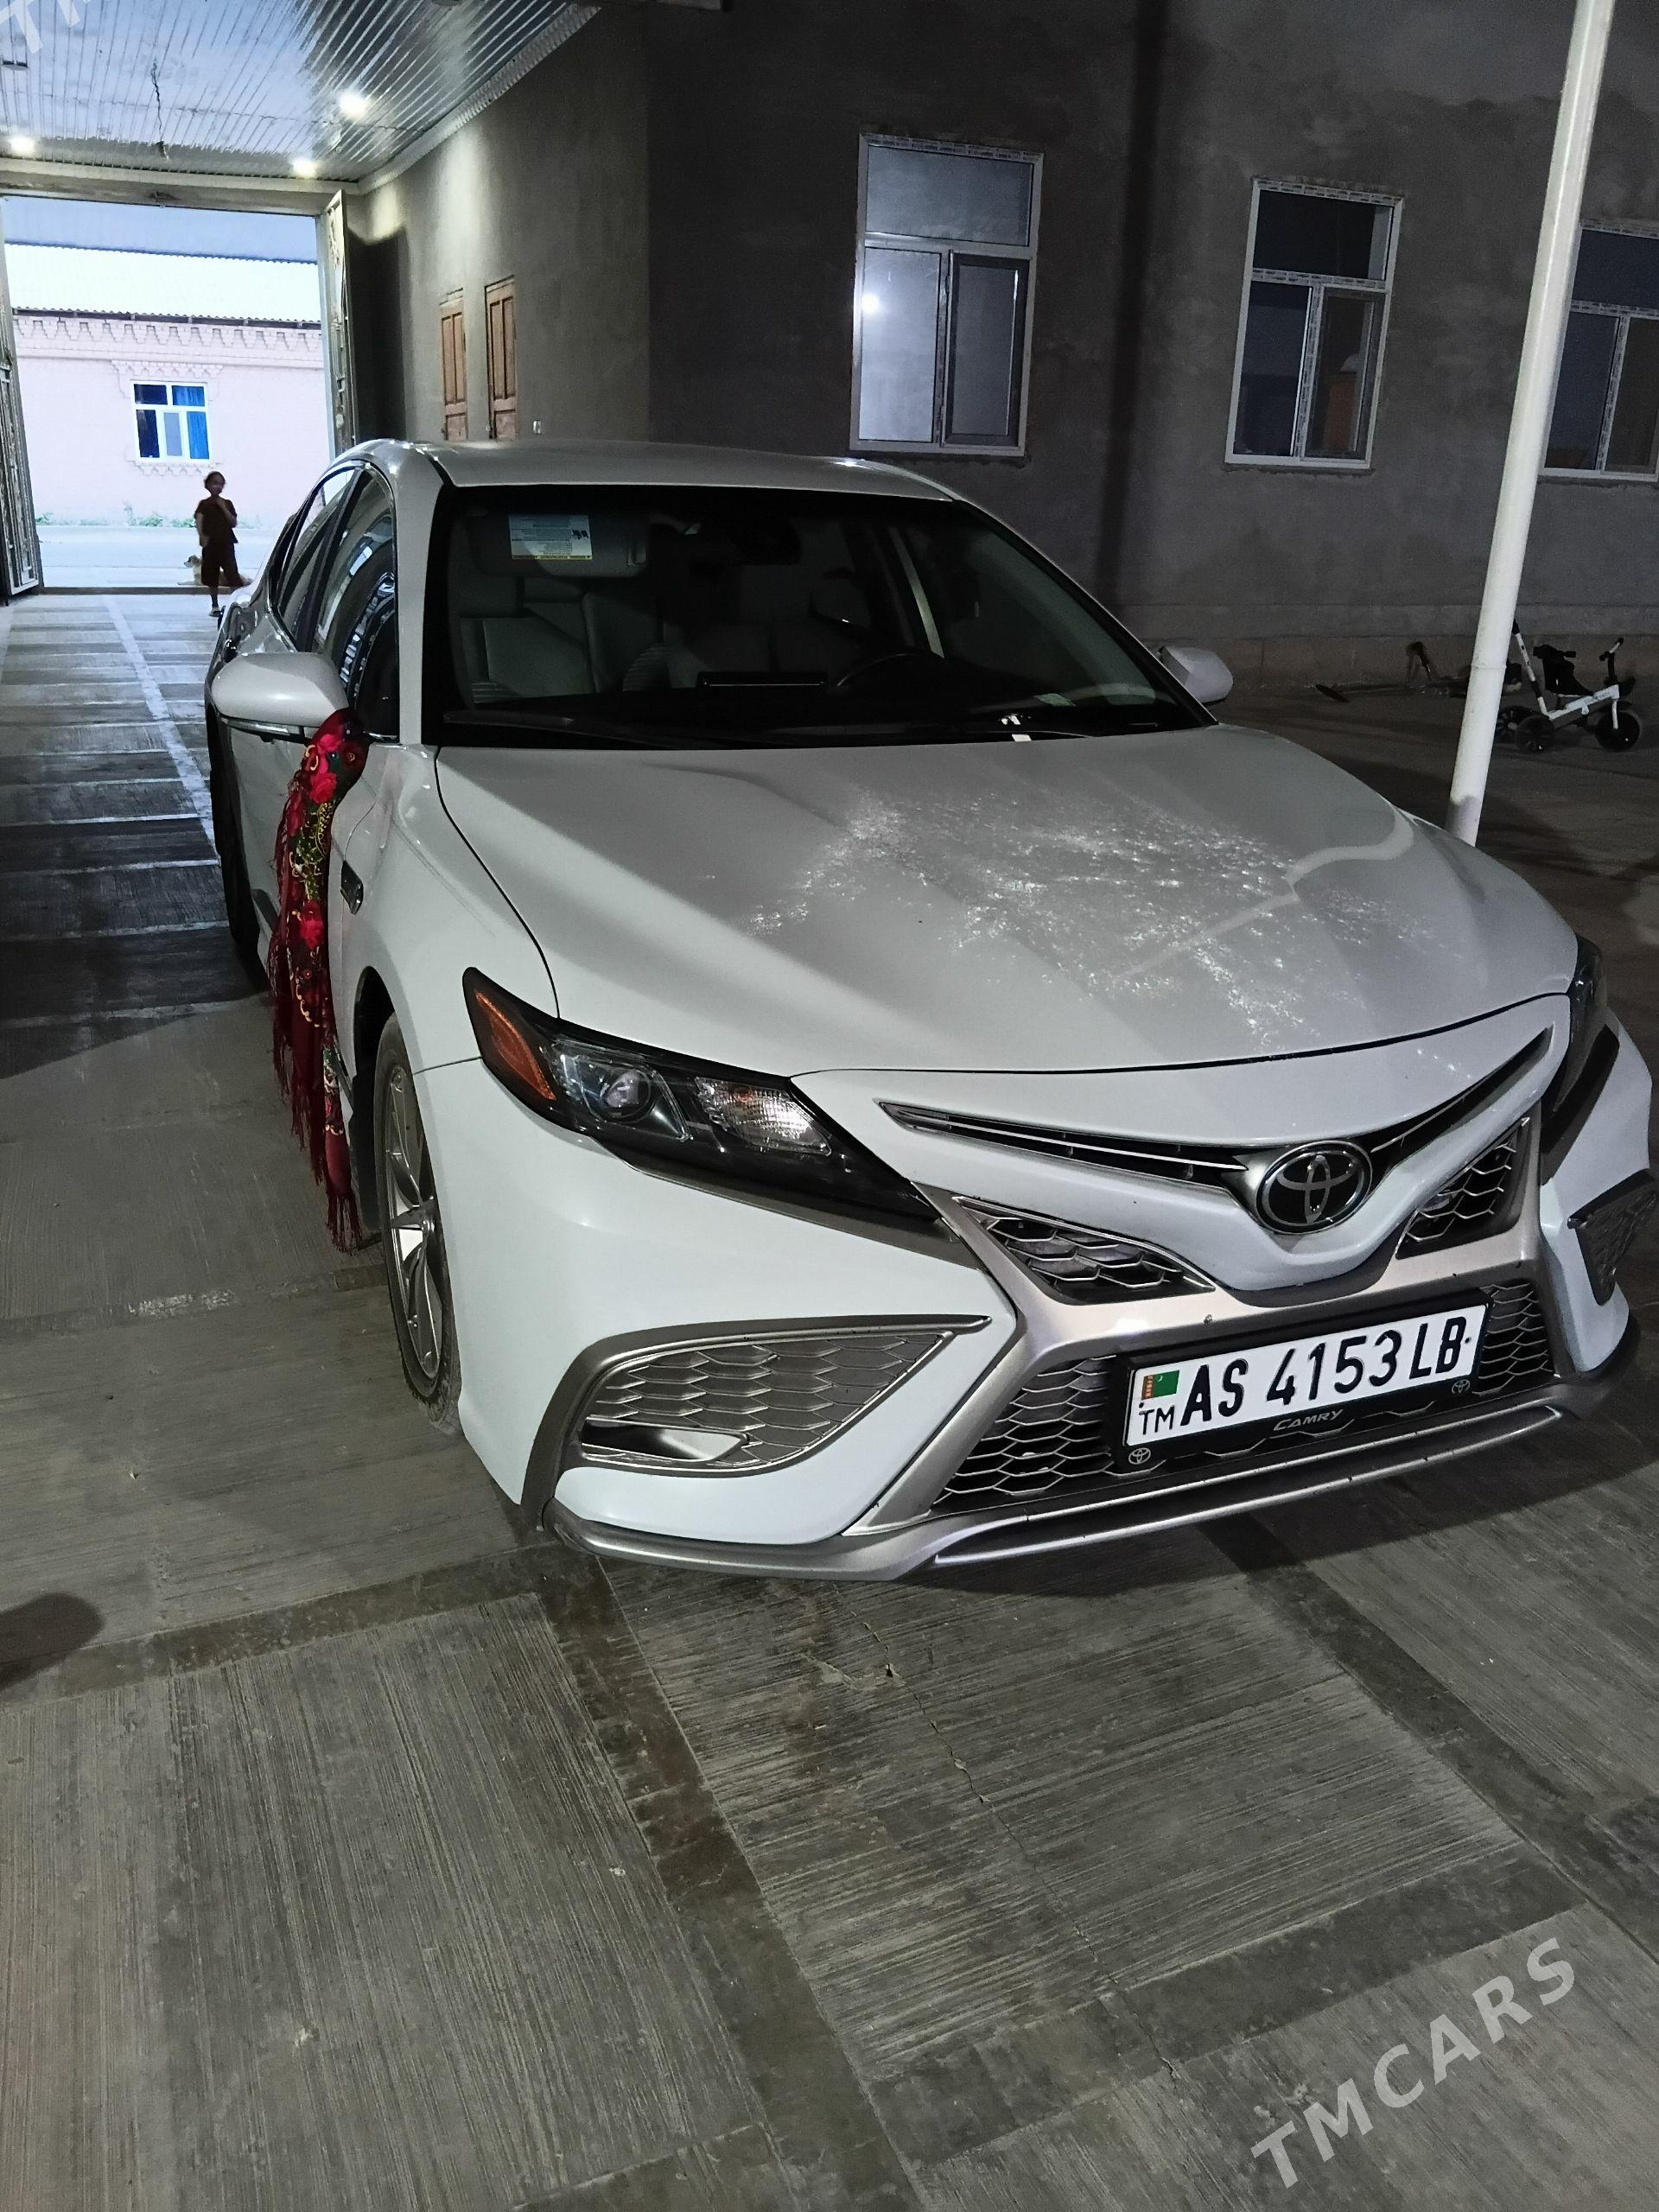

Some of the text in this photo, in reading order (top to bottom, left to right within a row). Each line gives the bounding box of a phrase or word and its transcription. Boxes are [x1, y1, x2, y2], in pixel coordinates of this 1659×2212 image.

[1180, 1358, 1249, 1426] AS
[1139, 1405, 1175, 1435] TM
[1273, 1408, 1344, 1431] CAMRY
